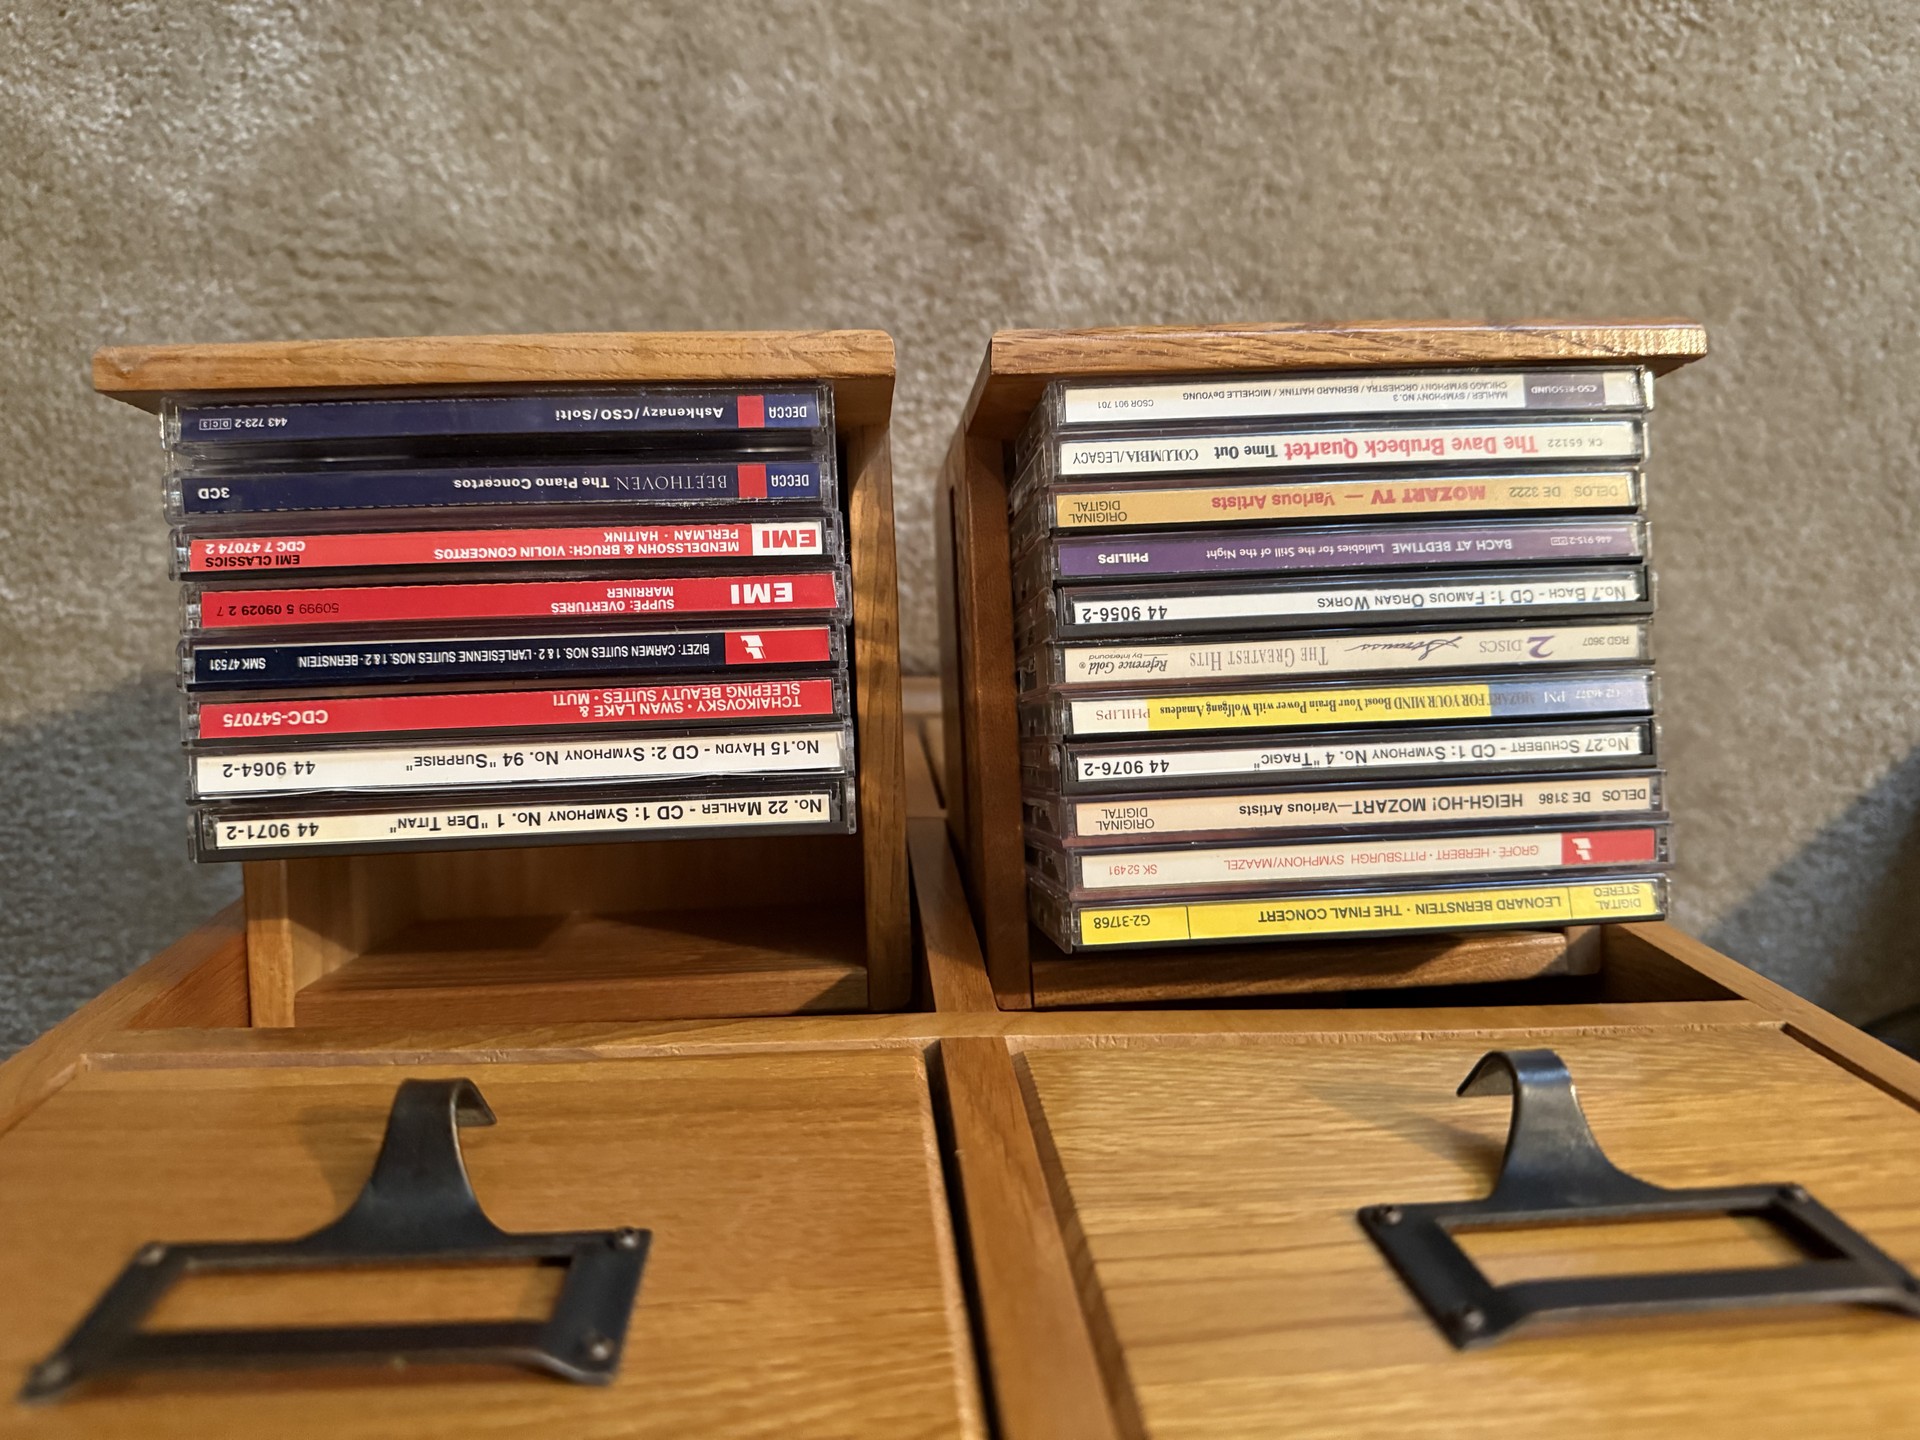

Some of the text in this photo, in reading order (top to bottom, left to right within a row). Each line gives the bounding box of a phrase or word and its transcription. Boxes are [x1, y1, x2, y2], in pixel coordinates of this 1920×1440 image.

[1183, 382, 1507, 400] CHICAGO SYMPHONY ORCHESTRA BERNARD HAITINK MICHELLE DeYOUNG
[1417, 391, 1508, 400] MAHLER SYMPHONY
[1114, 400, 1129, 408] 901
[768, 406, 807, 418] DECCA
[235, 417, 287, 429] 443 723-2
[1214, 436, 1538, 460] The Dave Brubeck Quartet Time Out
[1547, 437, 1603, 448] CK 65122
[453, 477, 610, 490] The Piano Concertos
[771, 474, 809, 487] DECCA
[198, 487, 230, 499] 3CD
[1212, 486, 1485, 510] MOZART TV Various Artists
[1509, 485, 1618, 498] DELOS DE 3222
[1074, 501, 1120, 511] DIGITAL
[1069, 512, 1128, 522] ORIGINAL
[604, 529, 738, 542] PERLMAN HAITINK
[762, 529, 816, 548] EMI
[206, 541, 306, 554] CDC 7 47074 2
[434, 541, 739, 560] MENDELSSOHN & BRUCH: VIOLIN CONCERTOS
[1206, 538, 1512, 560] BACH AT BEDTIME Lullabies for the Still of the Night
[206, 554, 300, 568] EMI CLASSICS
[1098, 553, 1149, 563] PHILIPS
[607, 586, 674, 598] MARRINER
[731, 582, 793, 604] EMI
[551, 599, 674, 613] SUPPÉ: OVERTURES
[1318, 588, 1585, 611] BACH CD 1: FAMOUS ORGAN WORKS
[217, 603, 339, 616] 50999 5 09029 2 7
[1082, 605, 1167, 622] 44 9056-2
[1479, 635, 1555, 658] 2 DISCS
[1582, 636, 1629, 646] RGD 3607
[299, 643, 710, 667] BIZET: CARMEN SUITES NOS. SUITES NOS. BERNSTEIN
[1189, 647, 1328, 671] THE GREATEST HITS
[242, 658, 266, 669] SMK
[1088, 657, 1168, 675] Reference Gold
[553, 683, 800, 706] SLEEPING BEAUTY SUITES MUTI
[579, 696, 801, 717] TCHAIKOVSKY SWAN LAKE &
[1160, 694, 1484, 718] FOR YOUR MIND Boost Your Brain Power with Wolfgang Amadeus
[223, 710, 328, 727] CDC-547075
[1096, 708, 1151, 720] PHILIPS
[406, 742, 765, 771] HAYDN CD 2: SYMPHONY No. 94 "SURPRISE"
[1254, 740, 1580, 770] SCHUBERT CD 1: SYMPHONY No. 4 "TRAGIC"
[222, 761, 315, 778] 44 9064-2
[1084, 759, 1170, 776] 44 9076-2
[1538, 789, 1646, 804] DELOS DE 3186
[1239, 794, 1522, 817] HEIGH-HO! Artists
[390, 799, 822, 834] No. 22 MAHLER CD 1: SYMPHONY No. "DER TITAN"
[1101, 808, 1148, 818] DIGITAL
[226, 823, 319, 840] 44 9071-2
[1096, 819, 1154, 831] ORIGINAL
[1224, 845, 1538, 870] GROFÉ HERBERT PITTSBURGH SYMPHONY/MAAZEL
[1142, 864, 1157, 874] SK
[1594, 885, 1640, 897] STEREO
[1258, 897, 1561, 922] LEONARD BERNSTEIN THE FINAL CONCERT
[1596, 898, 1641, 910] DIGITAL
[1093, 914, 1150, 928] G2-31768
